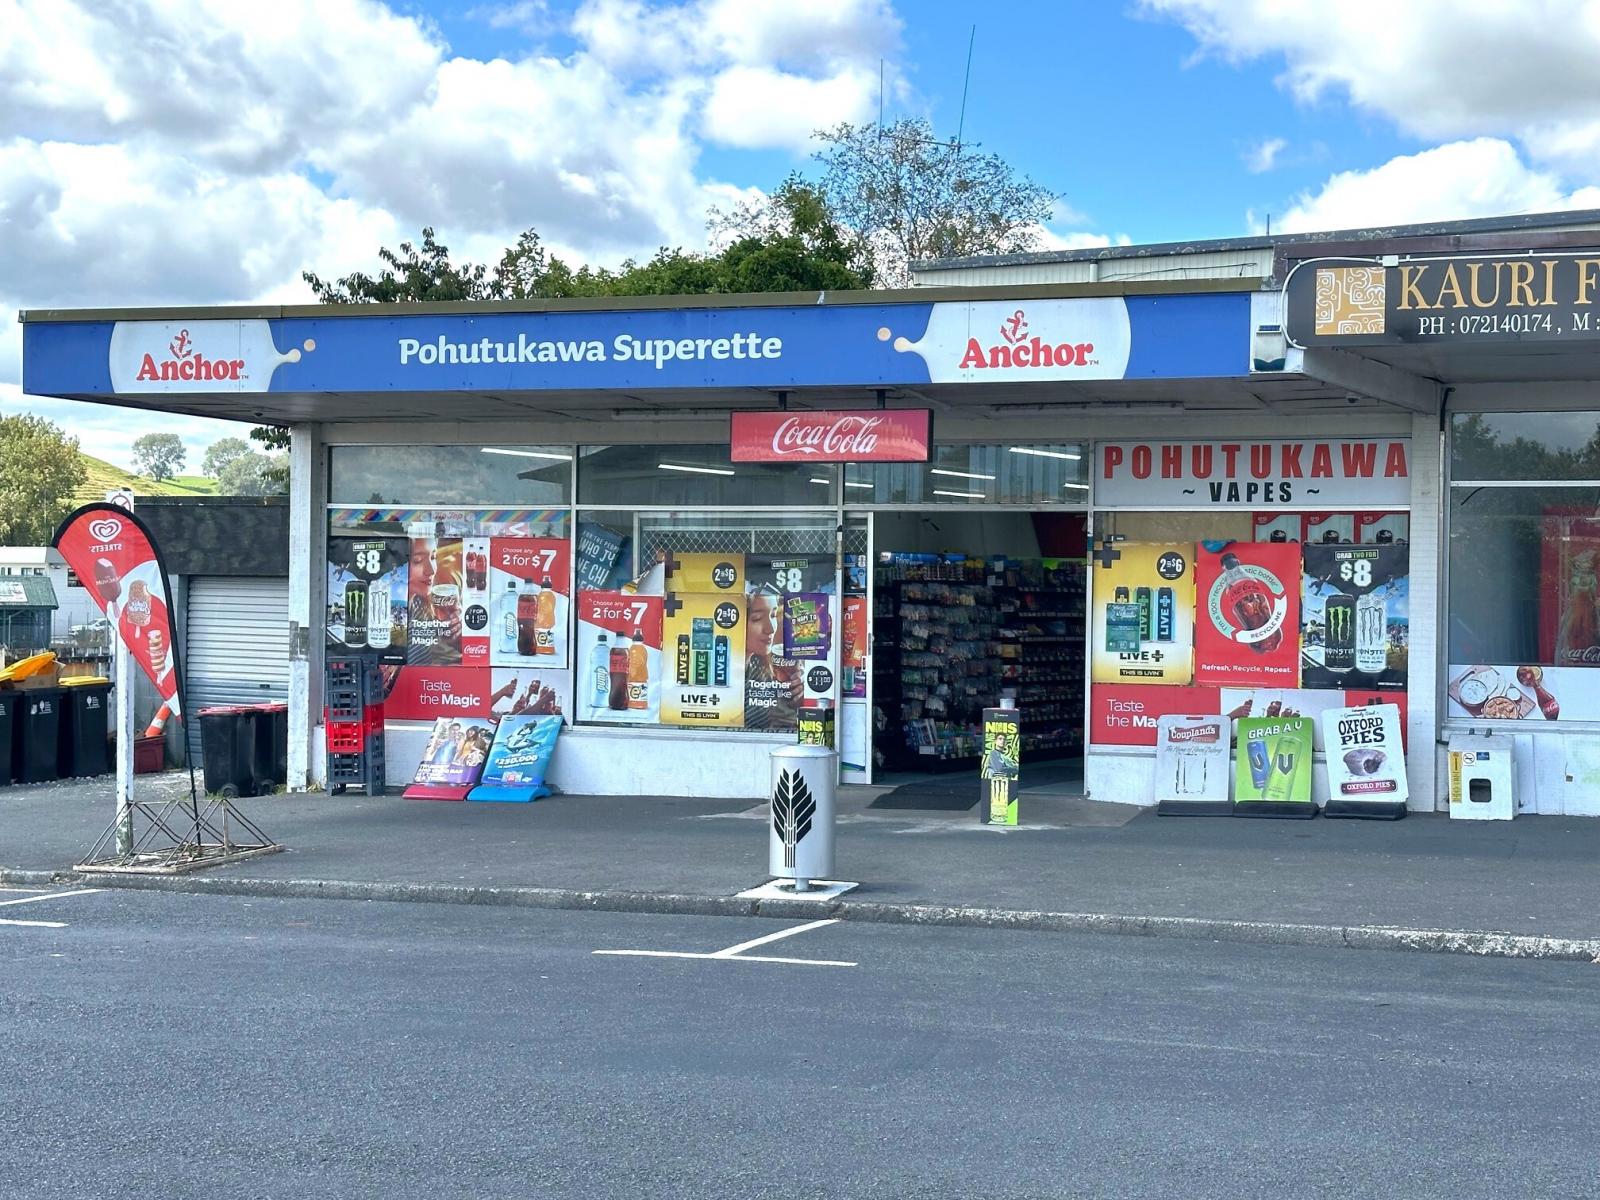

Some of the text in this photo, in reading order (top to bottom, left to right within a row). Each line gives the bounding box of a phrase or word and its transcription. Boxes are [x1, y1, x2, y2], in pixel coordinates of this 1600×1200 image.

[1396, 259, 1559, 310] KAURI
[398, 331, 783, 370] Pohutukawa Superette
[771, 415, 884, 455] Coca-Cola
[1103, 442, 1409, 480] POHUTUKAWA
[1208, 481, 1292, 503] VAPES
[356, 550, 380, 574] $8
[502, 550, 557, 572] 2 for $7
[776, 568, 802, 592] $8
[1340, 559, 1372, 588] $8
[592, 602, 648, 626] 2 for $7
[412, 620, 451, 629] Together
[412, 628, 451, 636] tastes like
[1250, 612, 1282, 639] RECYCLE ME
[412, 636, 438, 646] Magic
[1201, 664, 1232, 672] Refresh,
[420, 679, 451, 690] Taste
[748, 680, 792, 690] Together
[420, 693, 480, 707] the Magic
[748, 690, 792, 698] tastes like
[748, 698, 778, 708] Magic
[1106, 698, 1145, 712] Taste
[1106, 714, 1158, 728] the Ma
[1338, 718, 1384, 736] OXFORD
[1248, 725, 1280, 739] GRAB
[1283, 723, 1292, 732] A
[1340, 727, 1386, 746] PIES
